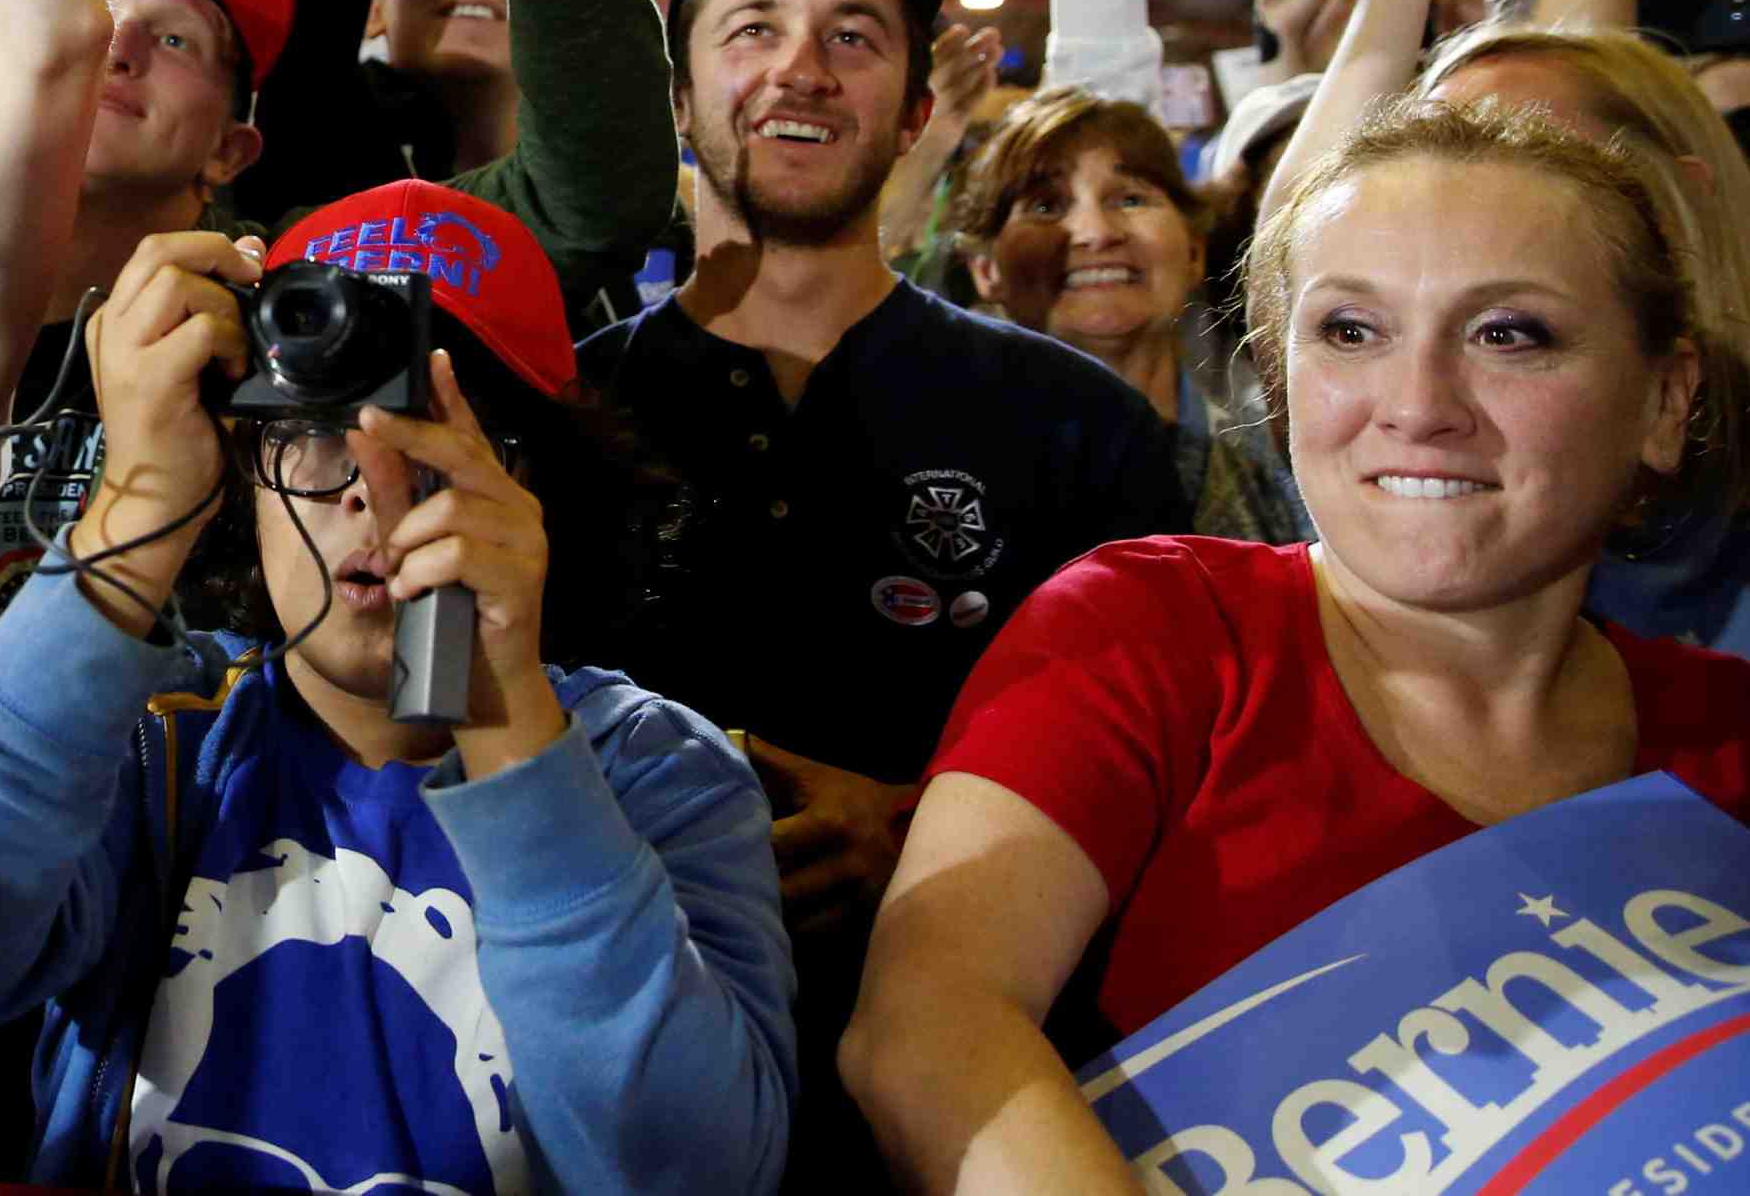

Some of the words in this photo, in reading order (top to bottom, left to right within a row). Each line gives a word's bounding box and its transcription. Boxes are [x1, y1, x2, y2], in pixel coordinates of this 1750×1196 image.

[304, 216, 418, 261] FEEL
[330, 249, 481, 298] ERN!
[367, 274, 410, 286] SONY
